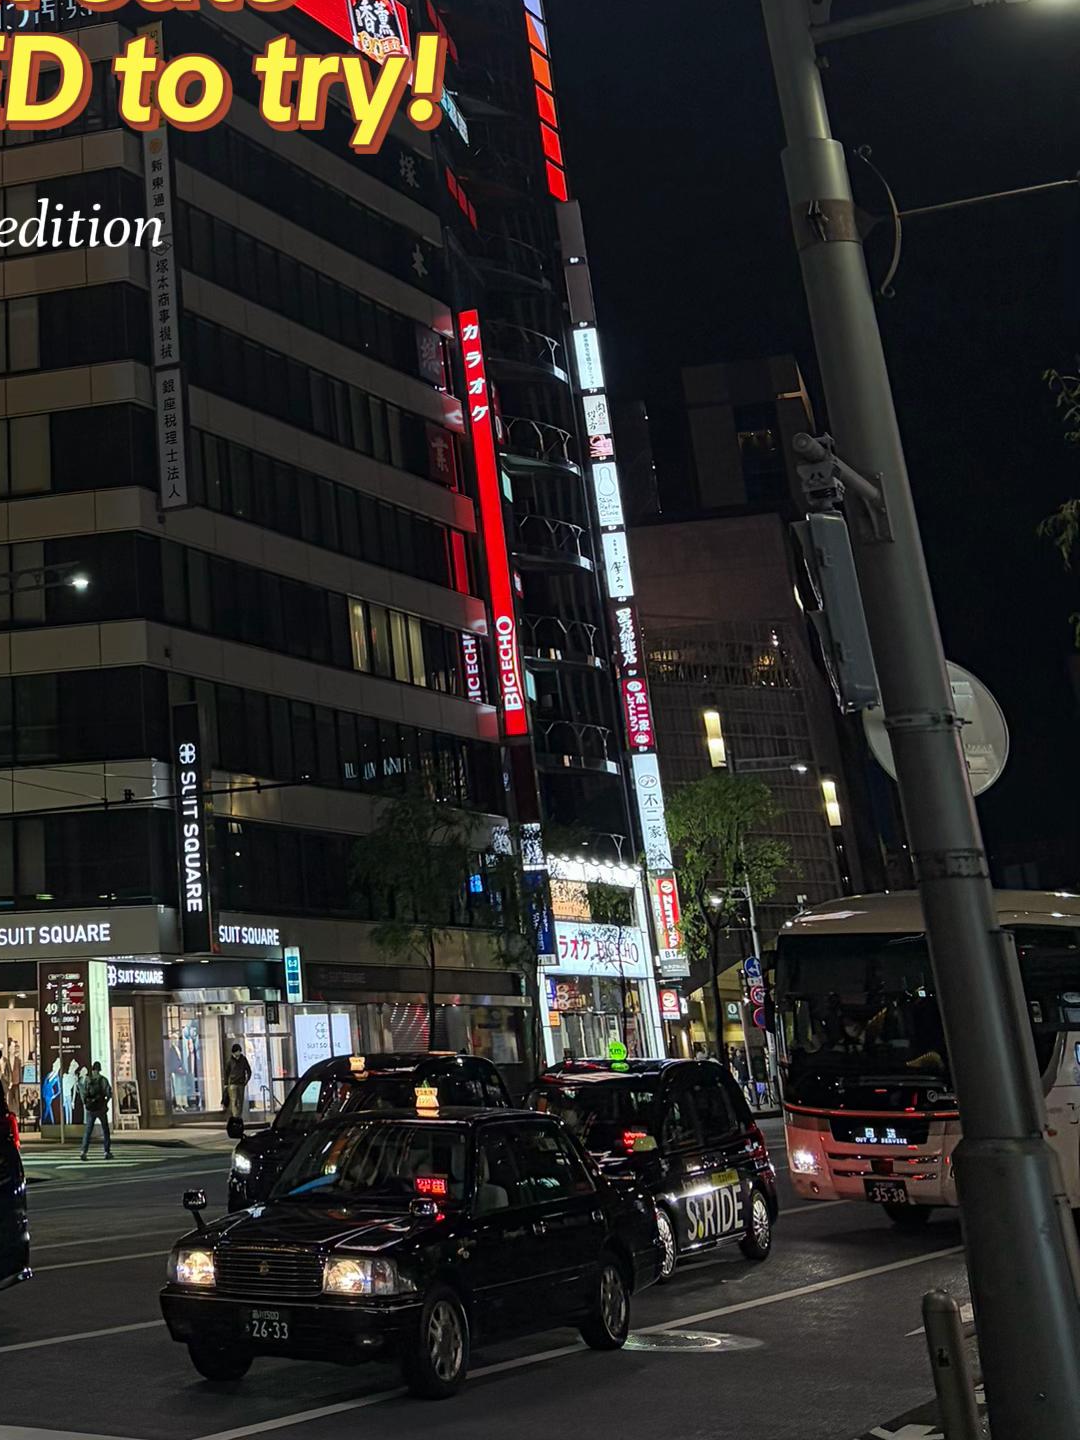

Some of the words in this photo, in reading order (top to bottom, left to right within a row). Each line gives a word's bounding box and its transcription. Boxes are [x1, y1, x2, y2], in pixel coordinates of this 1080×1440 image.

[461, 323, 490, 423] カラオケ
[162, 379, 181, 499] 銀座税理士法人
[635, 691, 651, 732] 不二家
[180, 771, 199, 820] SUIT
[183, 824, 204, 914] SQUARE
[38, 922, 112, 944] SQUARE
[218, 924, 241, 944] SUIT
[241, 927, 281, 947] SQUARE
[559, 934, 591, 961] ラオケ
[117, 968, 136, 983] SUIT
[136, 969, 164, 985] SQUARE
